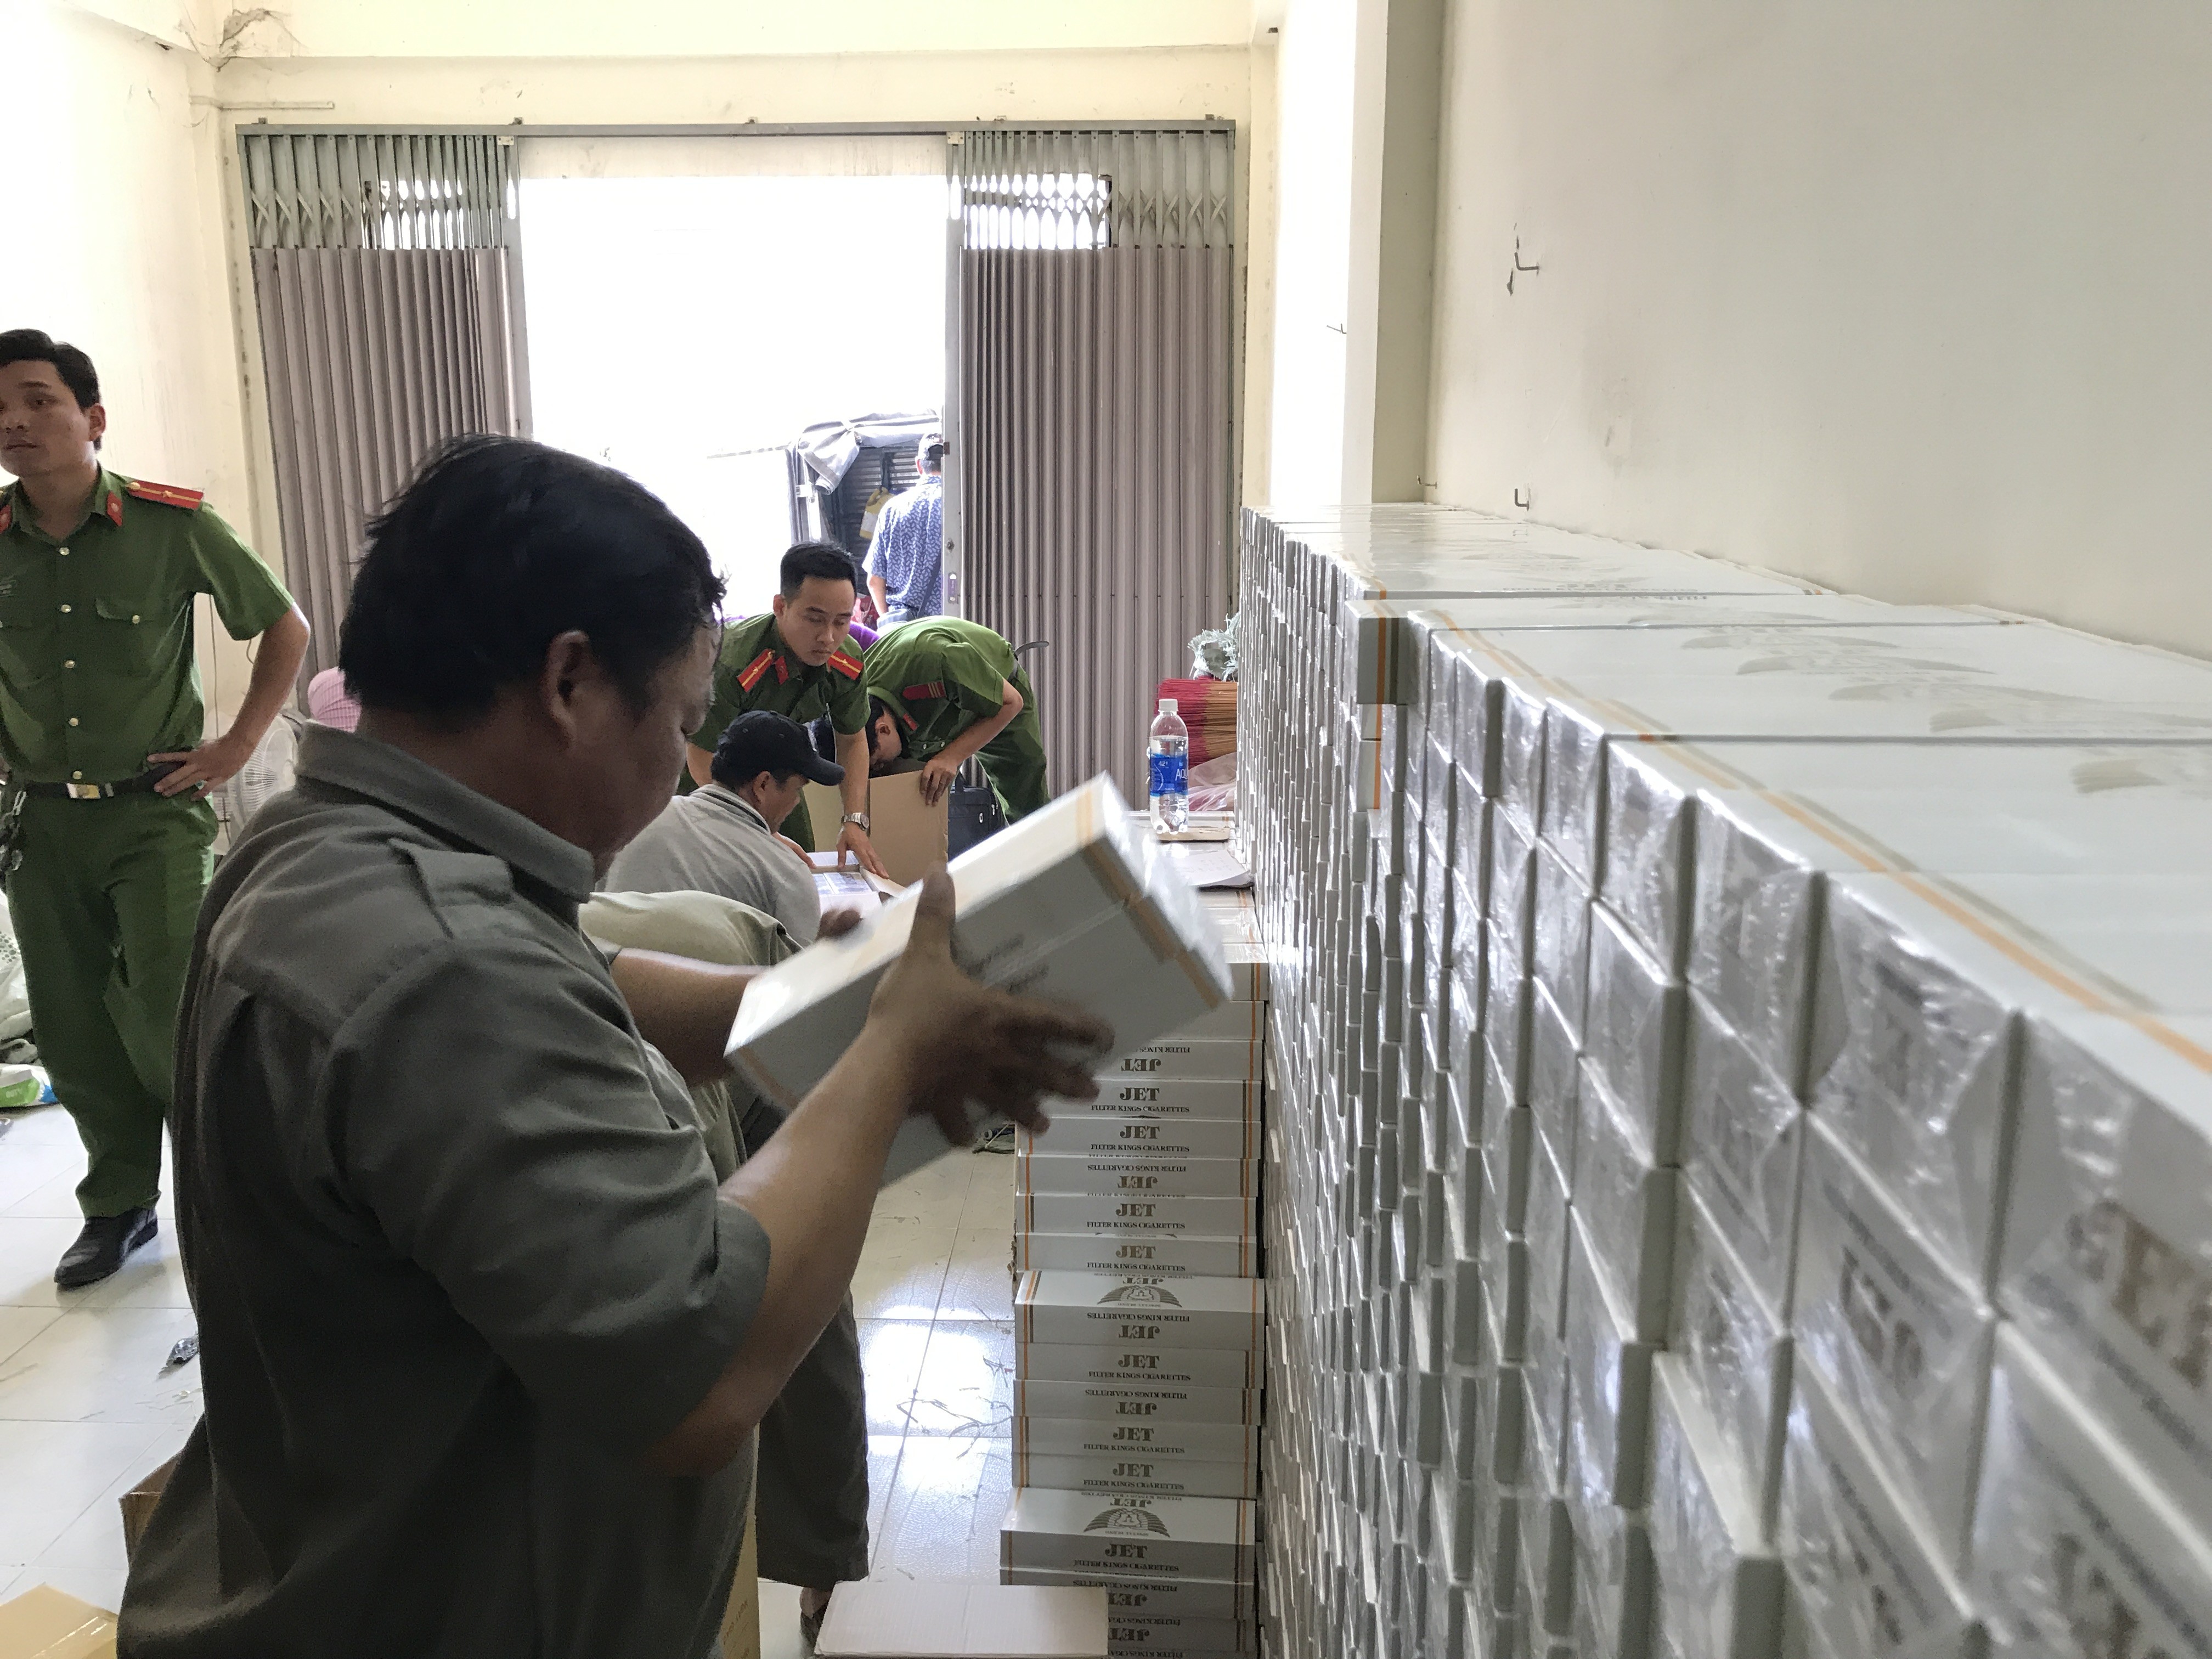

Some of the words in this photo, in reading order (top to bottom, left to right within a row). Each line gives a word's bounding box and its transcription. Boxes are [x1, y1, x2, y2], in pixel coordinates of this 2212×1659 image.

[1121, 1058, 1161, 1072] JET
[1120, 1087, 1160, 1101] JET
[1120, 1125, 1160, 1139] JET
[1117, 1175, 1158, 1189] JET
[1115, 1203, 1156, 1217] JET
[1115, 1245, 1156, 1259] JET
[1087, 1312, 1136, 1321] CIGARETTES
[1118, 1325, 1160, 1339] JET
[1118, 1354, 1160, 1369] JET
[1142, 1373, 1191, 1381] CIGARETTES
[1115, 1401, 1157, 1415] JET
[1113, 1426, 1154, 1442] JET
[1137, 1446, 1185, 1454] CIGARETTES
[1113, 1463, 1154, 1478] JET
[1136, 1481, 1184, 1490] CIGARETTES
[1110, 1498, 1152, 1508] JET
[1104, 1543, 1148, 1559] JET
[1103, 1561, 1128, 1569] KINGS
[1129, 1563, 1180, 1572] CIGARETTES
[1107, 1593, 1147, 1606] JET
[1107, 1628, 1150, 1641] JET
